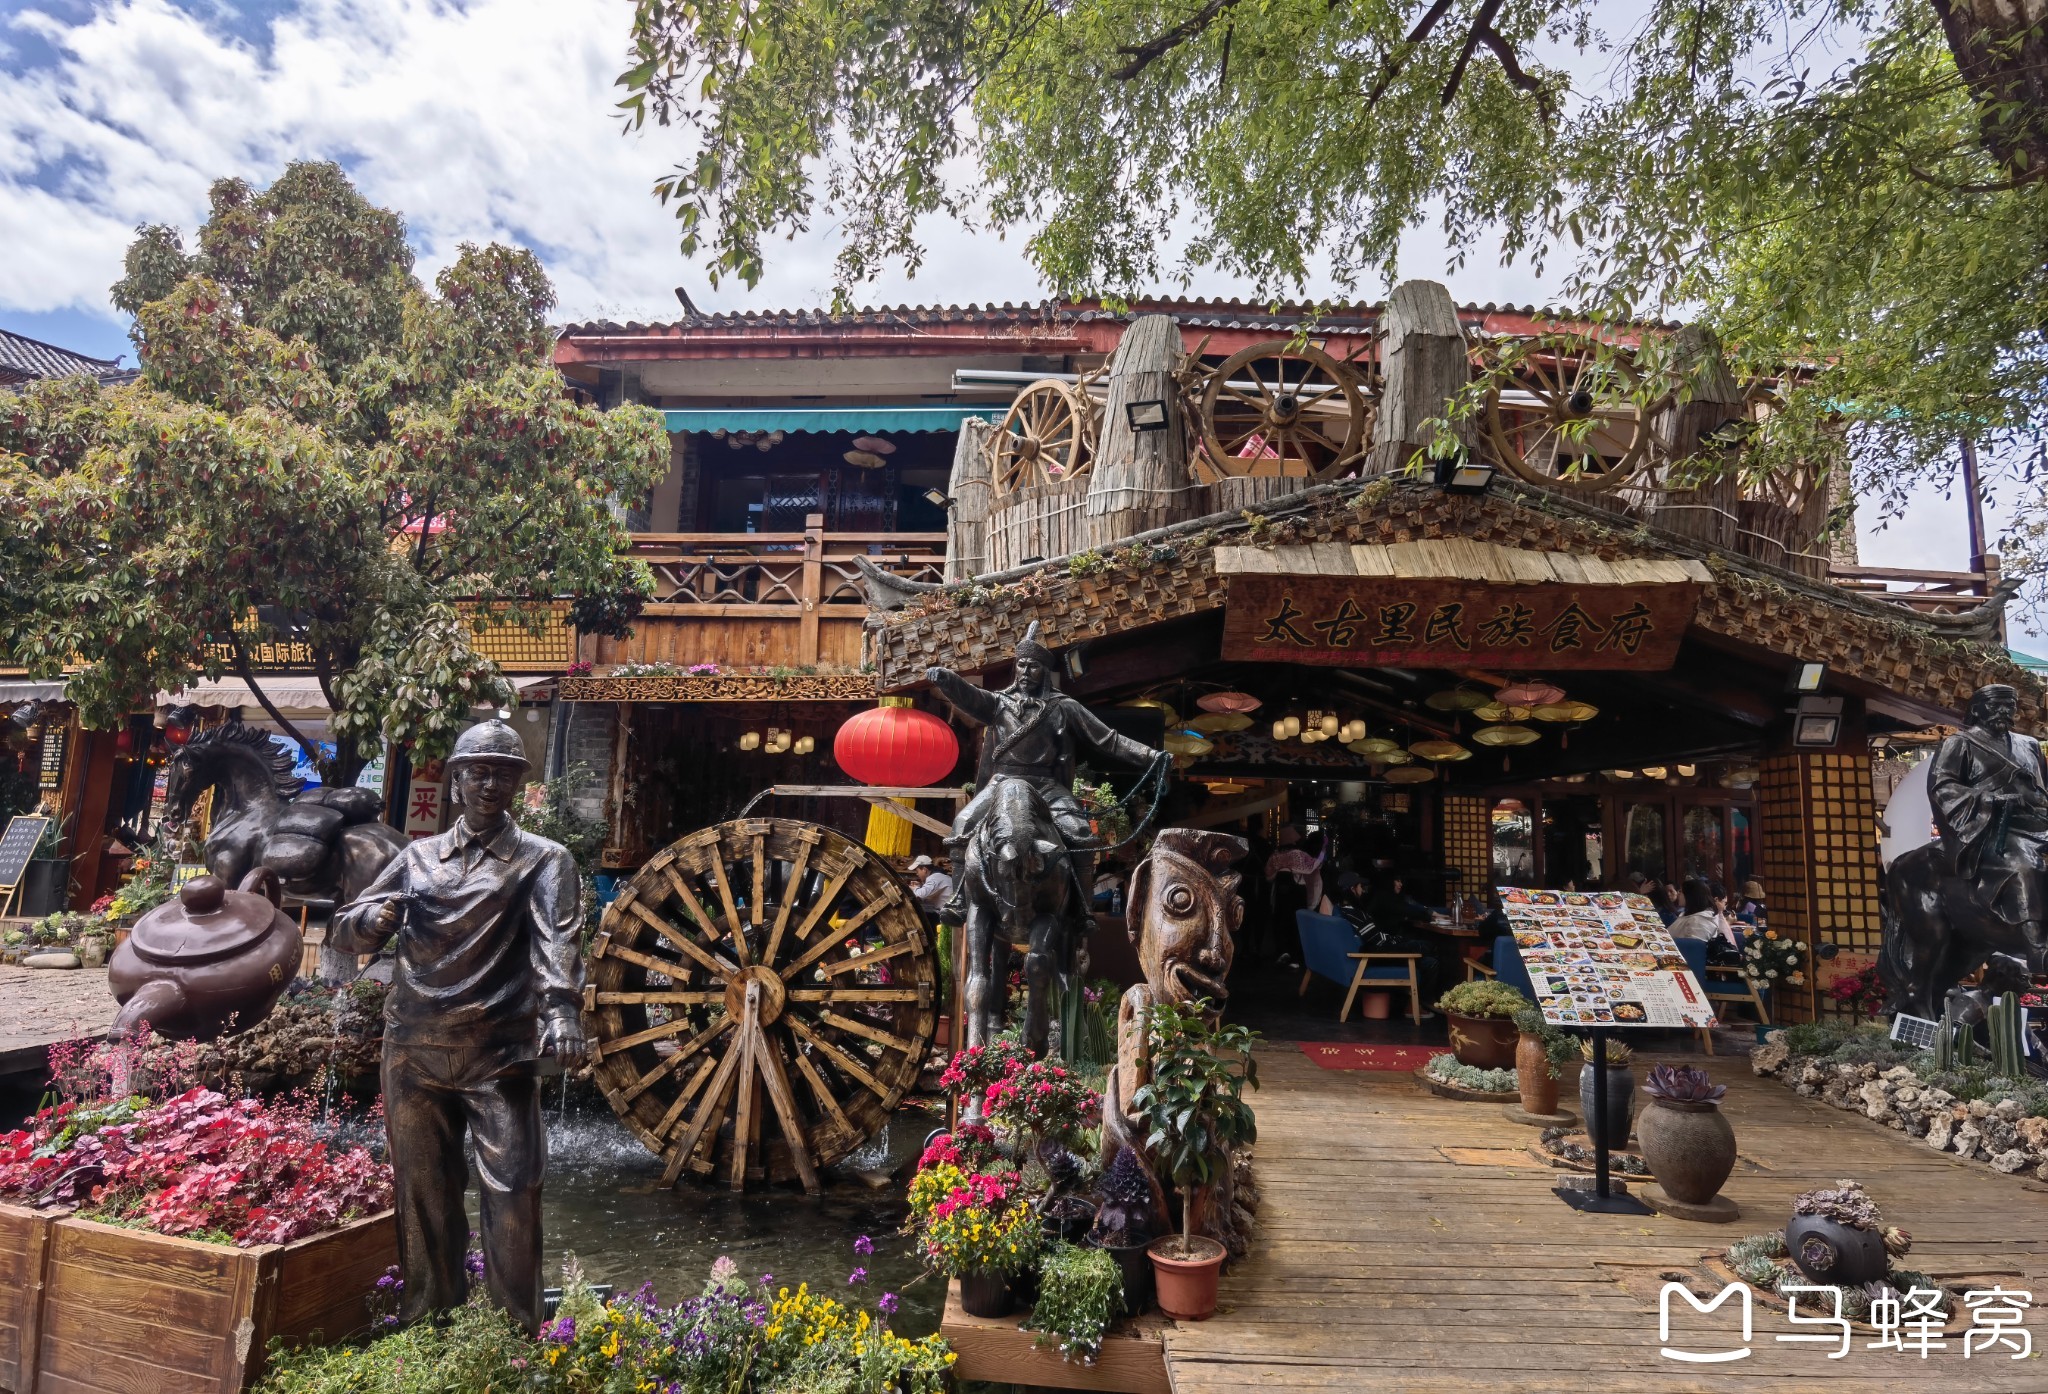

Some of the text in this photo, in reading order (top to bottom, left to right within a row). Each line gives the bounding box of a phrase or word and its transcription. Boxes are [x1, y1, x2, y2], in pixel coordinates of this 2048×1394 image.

[1254, 597, 1654, 655] 太古里民族食府
